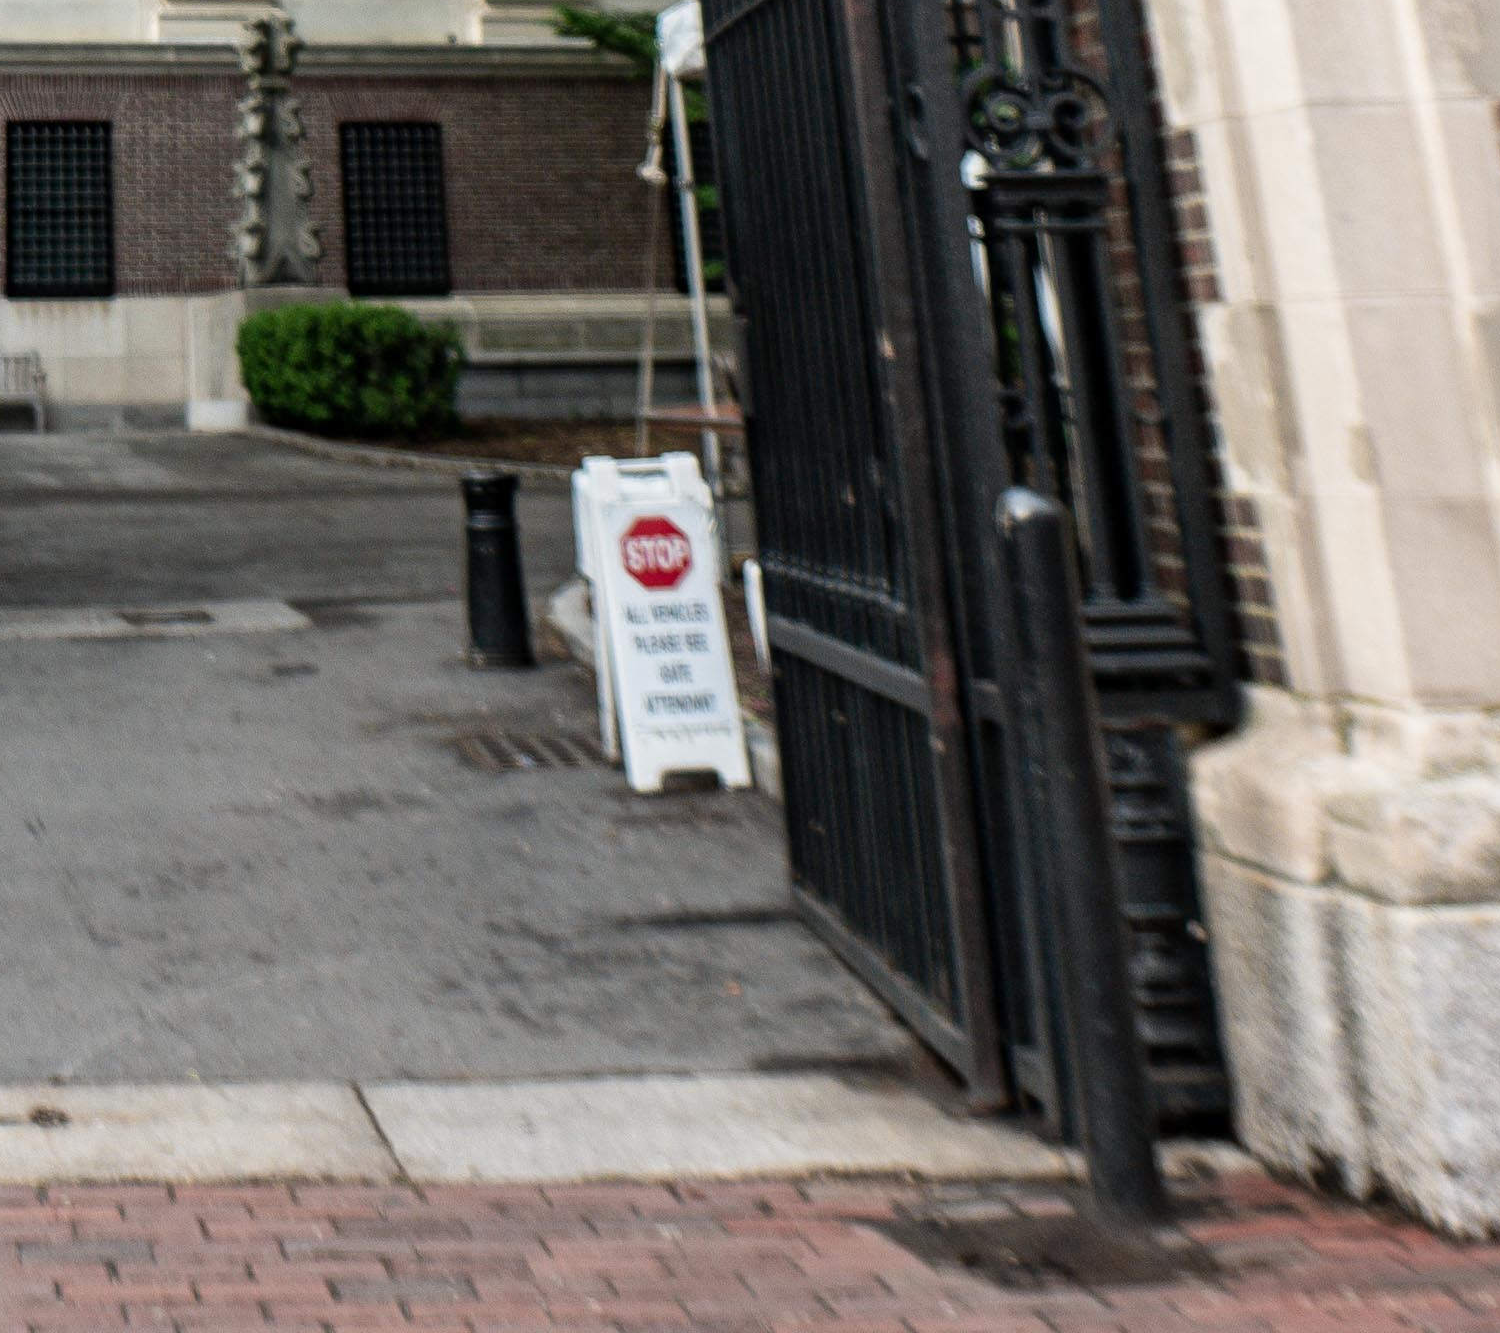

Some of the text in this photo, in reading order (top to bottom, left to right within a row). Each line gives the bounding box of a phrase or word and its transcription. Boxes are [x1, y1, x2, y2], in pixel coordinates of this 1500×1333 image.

[625, 536, 690, 572] STOP
[650, 601, 710, 623] VEHICLES
[633, 634, 682, 654] PLEASE
[659, 663, 693, 684] GATE
